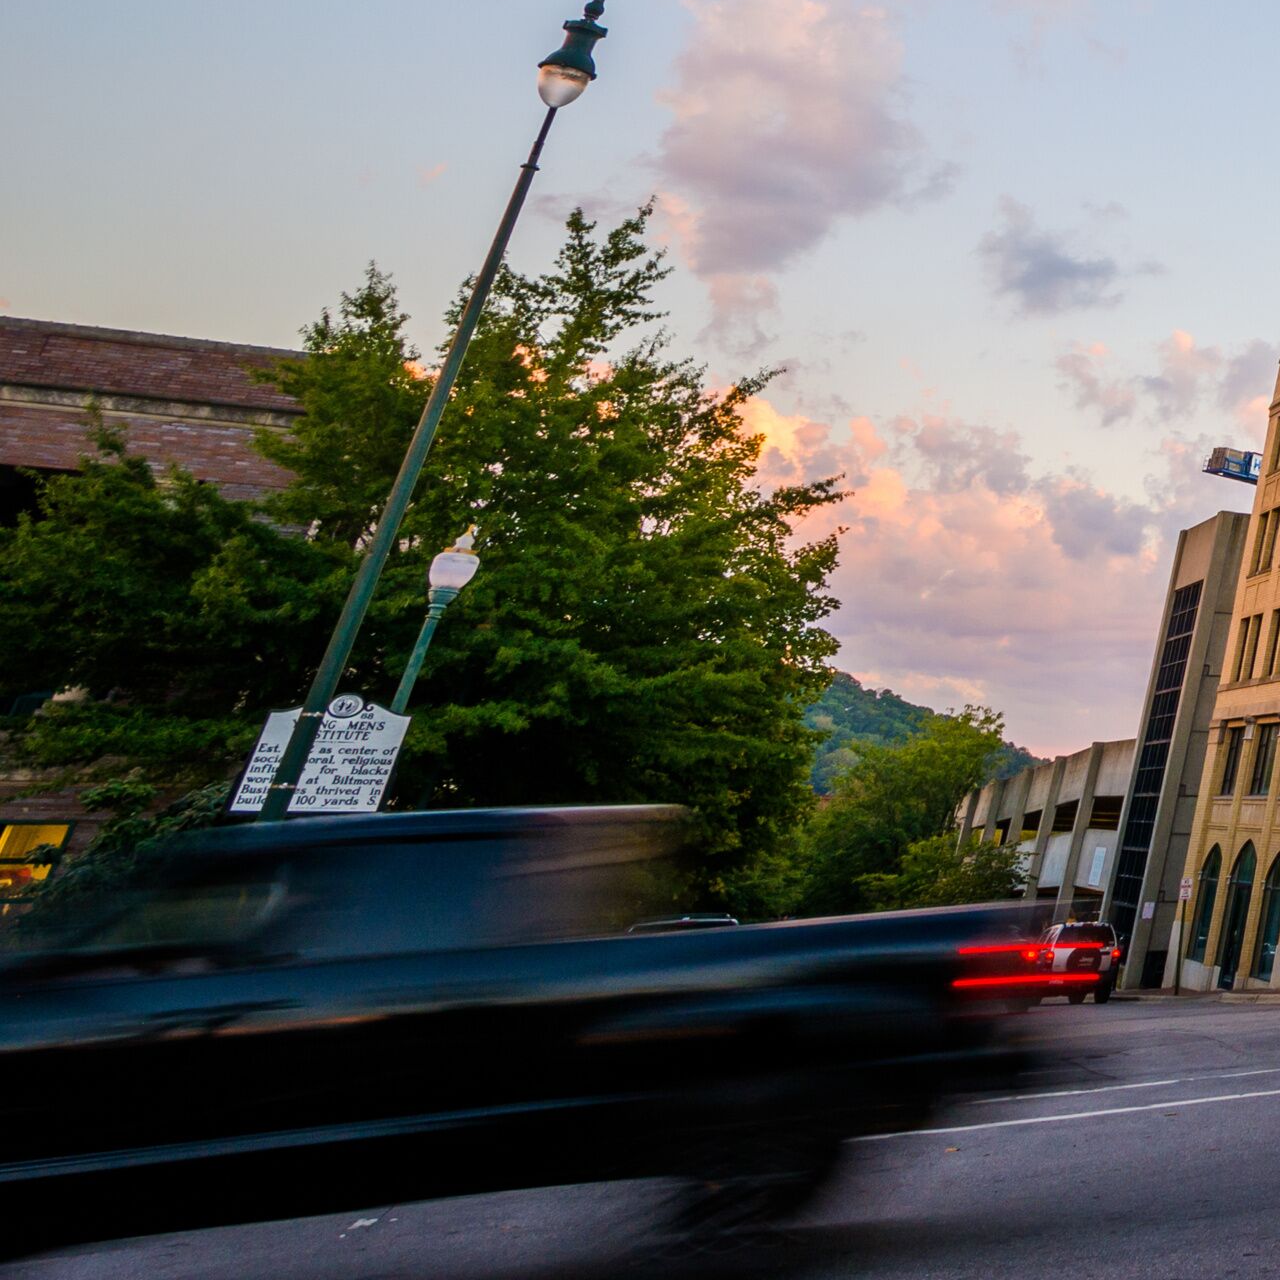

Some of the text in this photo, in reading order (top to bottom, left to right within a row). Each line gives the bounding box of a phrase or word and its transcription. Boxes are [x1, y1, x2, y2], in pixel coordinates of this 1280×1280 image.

[315, 730, 371, 741] STITUTE
[338, 745, 378, 756] center
[382, 746, 397, 756] of
[341, 756, 392, 766] religious
[319, 765, 338, 774] for
[350, 766, 389, 775] blacks
[305, 776, 319, 785] at
[316, 785, 361, 795] thrived
[369, 787, 381, 796] in
[295, 795, 316, 805] 100
[321, 796, 358, 806] yards
